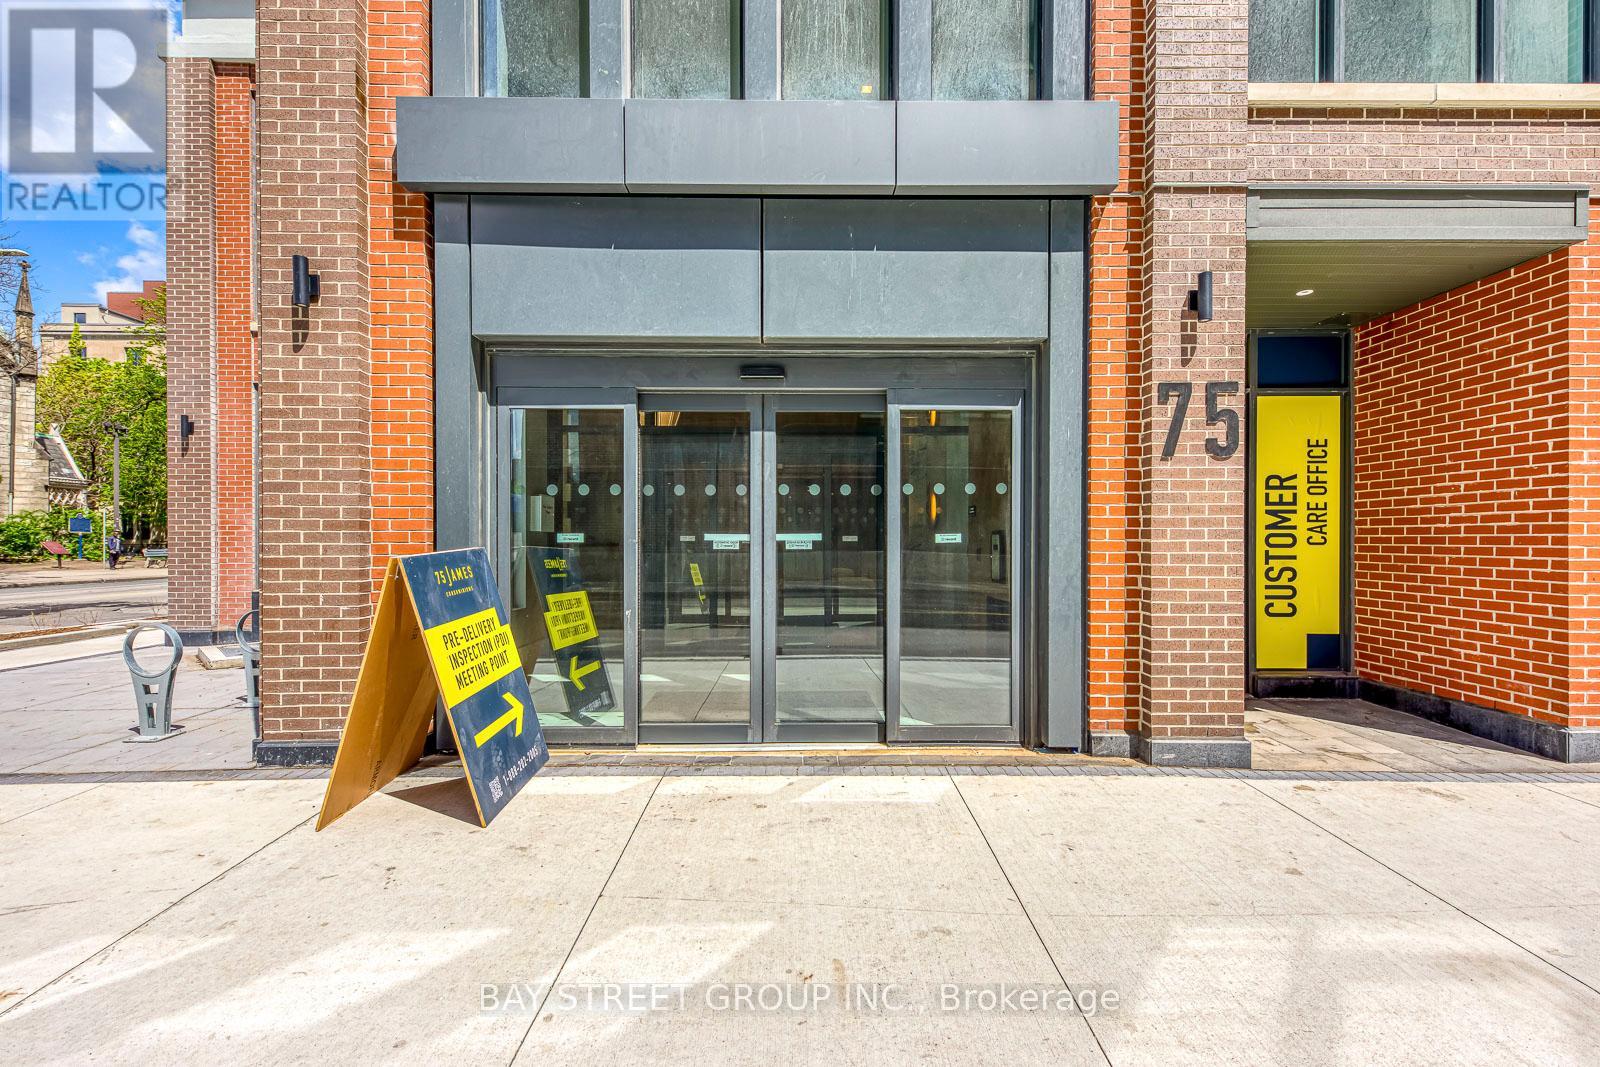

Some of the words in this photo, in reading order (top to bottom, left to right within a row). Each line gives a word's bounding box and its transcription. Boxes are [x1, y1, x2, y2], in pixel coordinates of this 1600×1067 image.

[1157, 381, 1240, 461] 75
[1306, 438, 1328, 496] OFFICE
[1306, 501, 1328, 546] CARE
[1264, 473, 1298, 618] CUSTOMER
[434, 570, 447, 585] 75
[442, 617, 496, 650] PRE-DELIVERY
[448, 637, 494, 670] INSPECTION
[455, 660, 489, 690] MEETING
[489, 649, 510, 672] POINT
